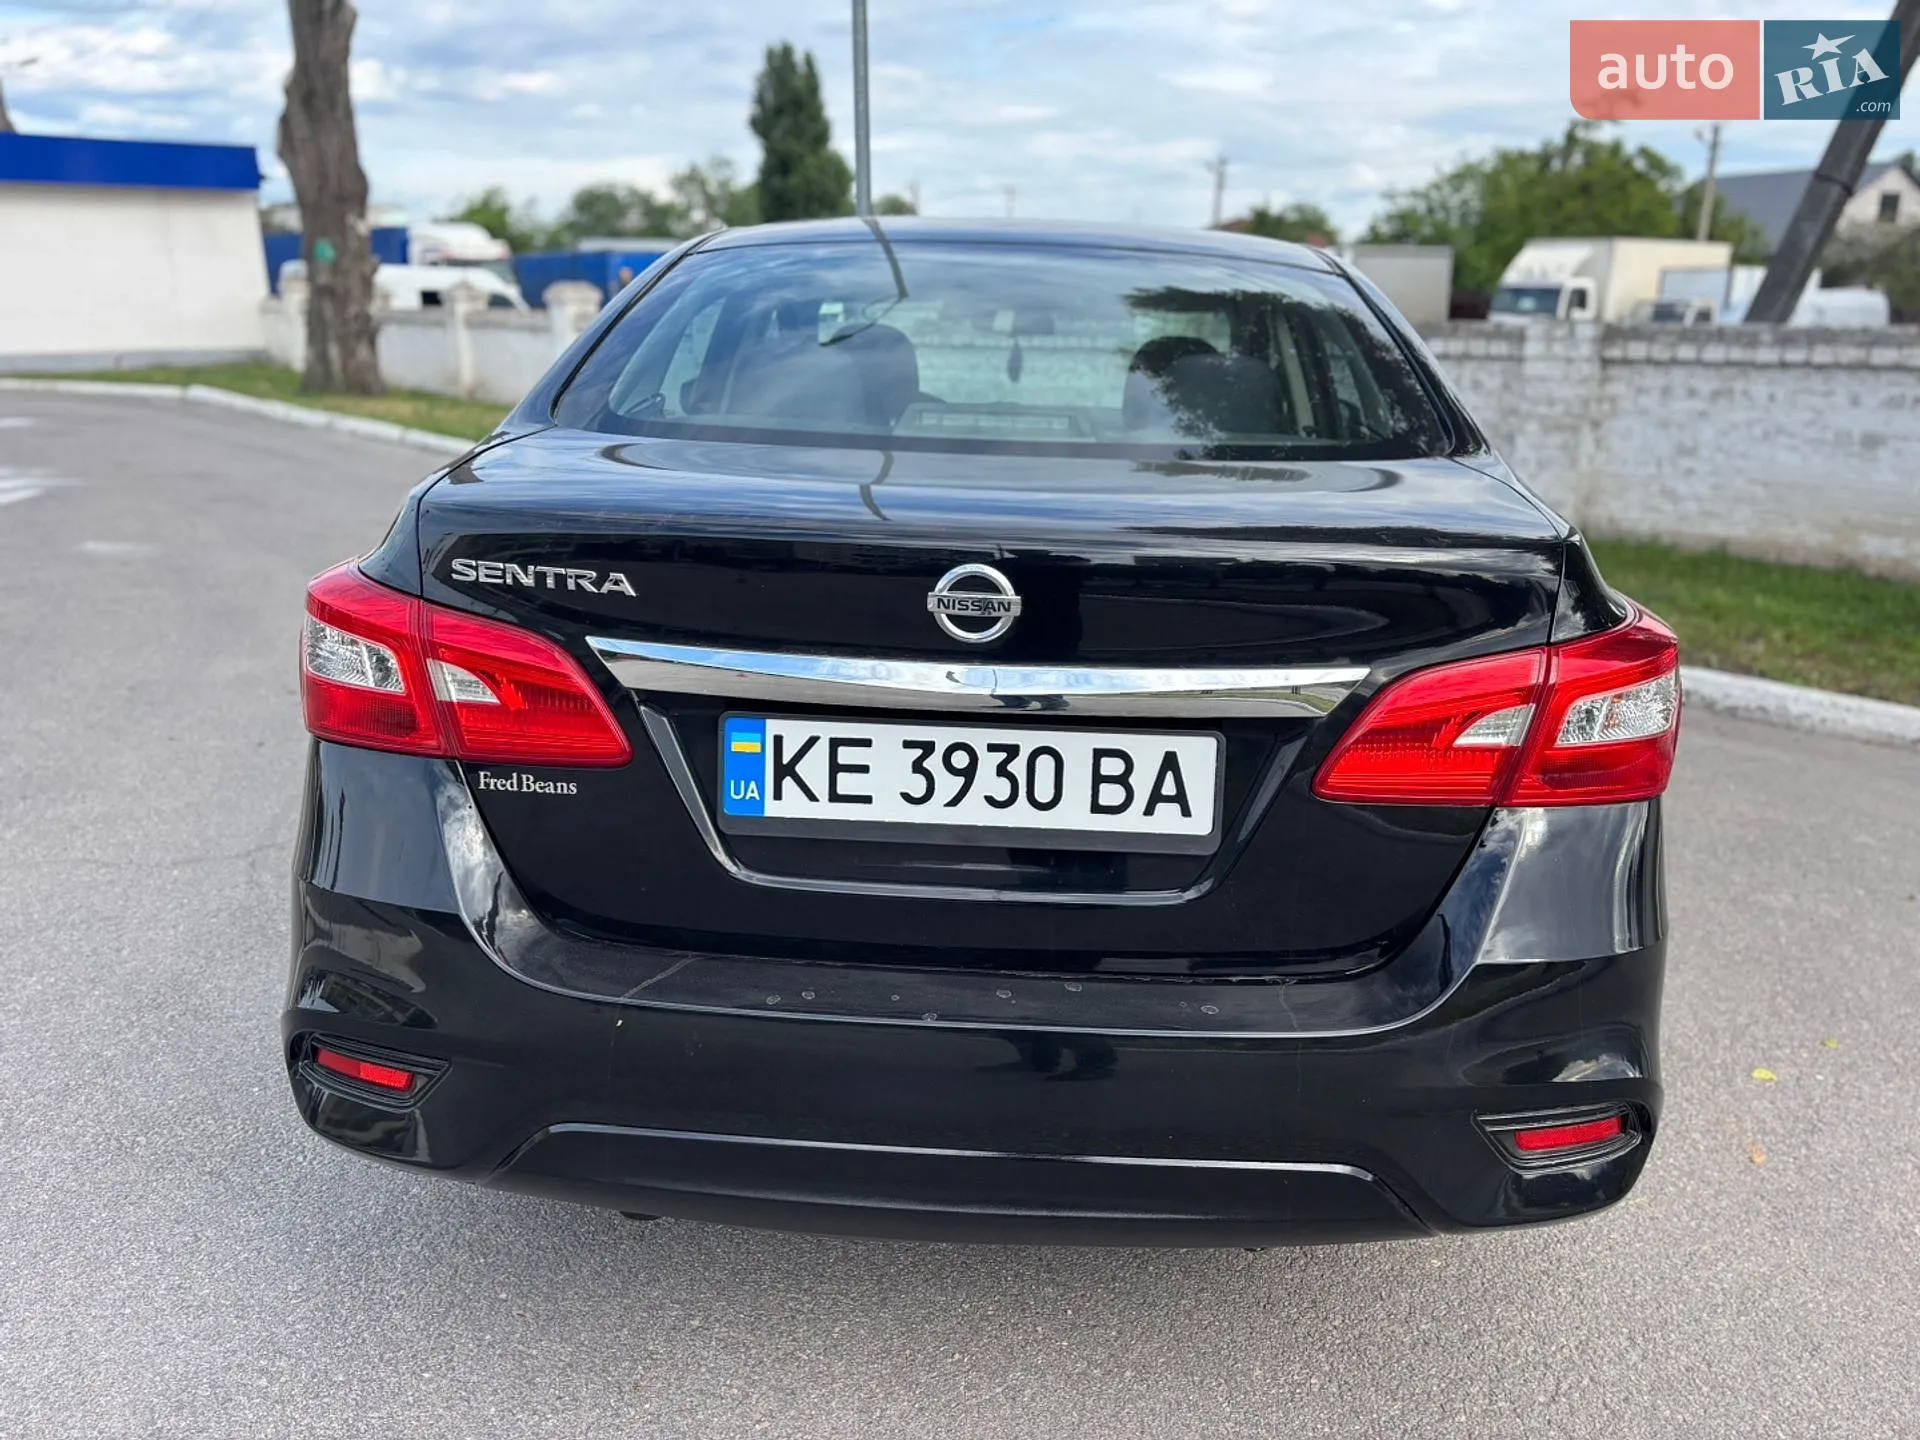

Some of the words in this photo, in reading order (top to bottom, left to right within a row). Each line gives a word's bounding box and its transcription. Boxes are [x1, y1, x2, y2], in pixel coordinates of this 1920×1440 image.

[451, 557, 637, 597] SENTRA
[937, 597, 1012, 613] NISSAN
[478, 771, 518, 792] Fred
[521, 774, 577, 795] Beans
[772, 734, 874, 805] KE
[899, 738, 1064, 812] 3930
[1090, 747, 1193, 818] BA
[730, 779, 760, 801] UA
